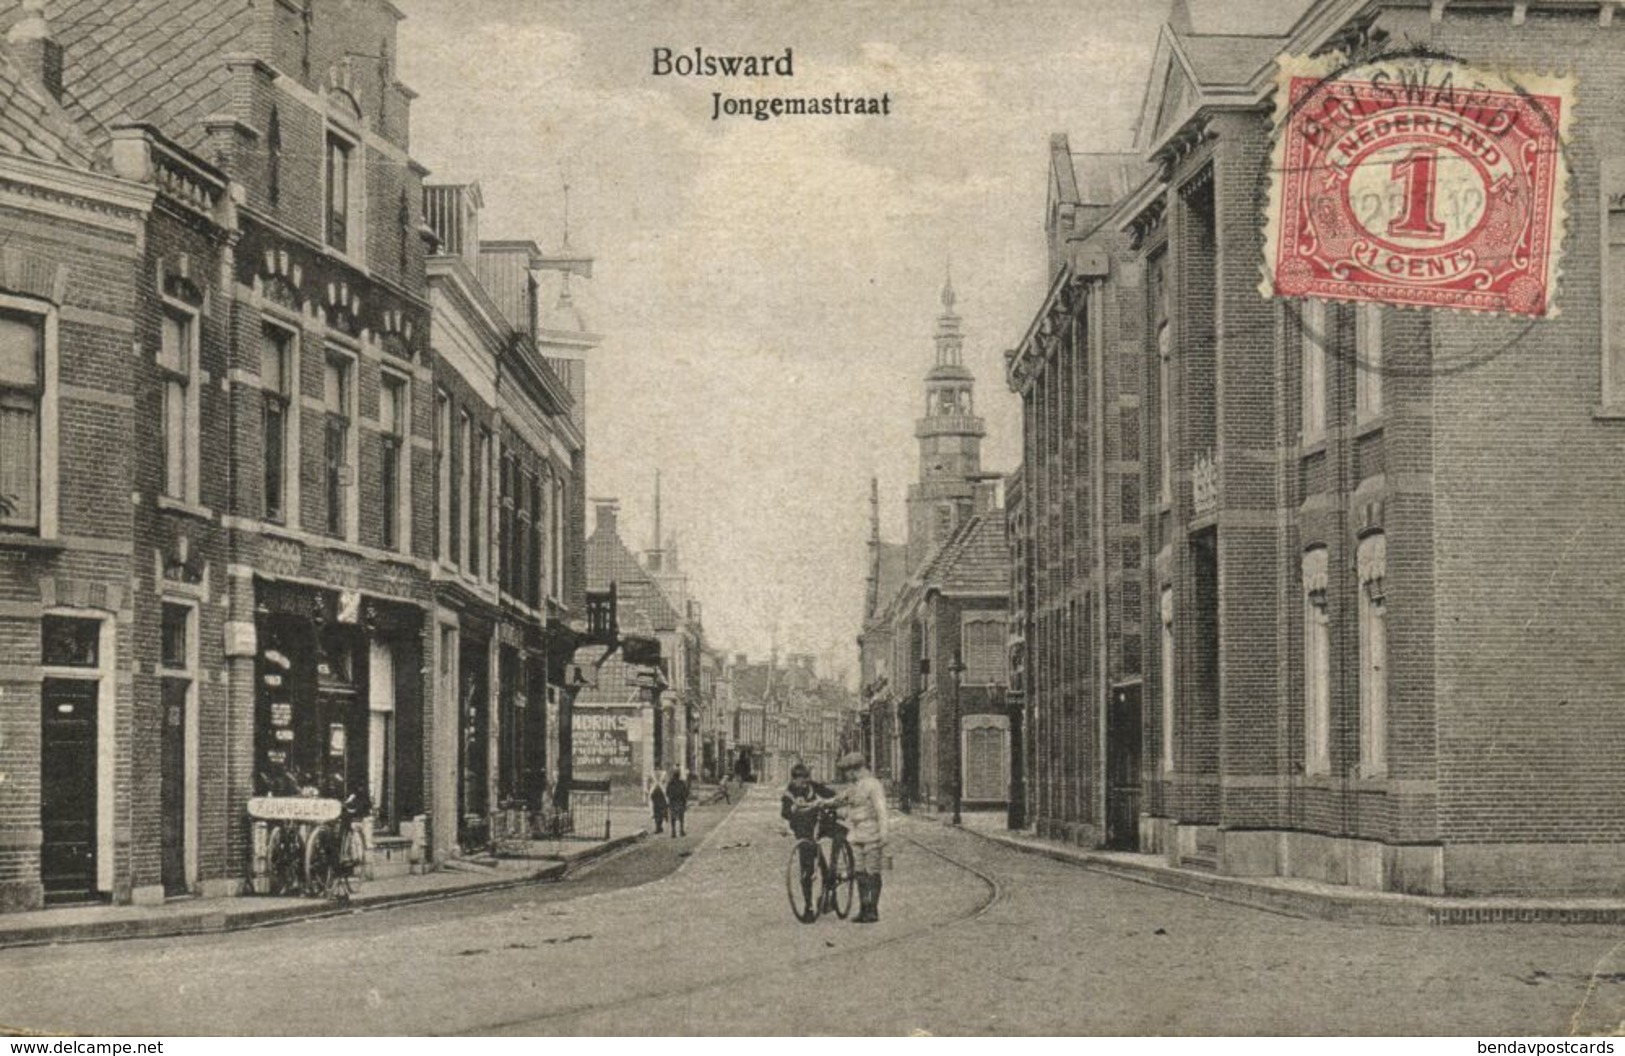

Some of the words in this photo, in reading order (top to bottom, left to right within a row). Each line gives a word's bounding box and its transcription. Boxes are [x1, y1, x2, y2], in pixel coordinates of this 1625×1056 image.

[1337, 113, 1501, 167] NEDERLAND
[1388, 147, 1445, 240] 1
[1367, 248, 1379, 266] 1
[1386, 251, 1461, 277] CENT
